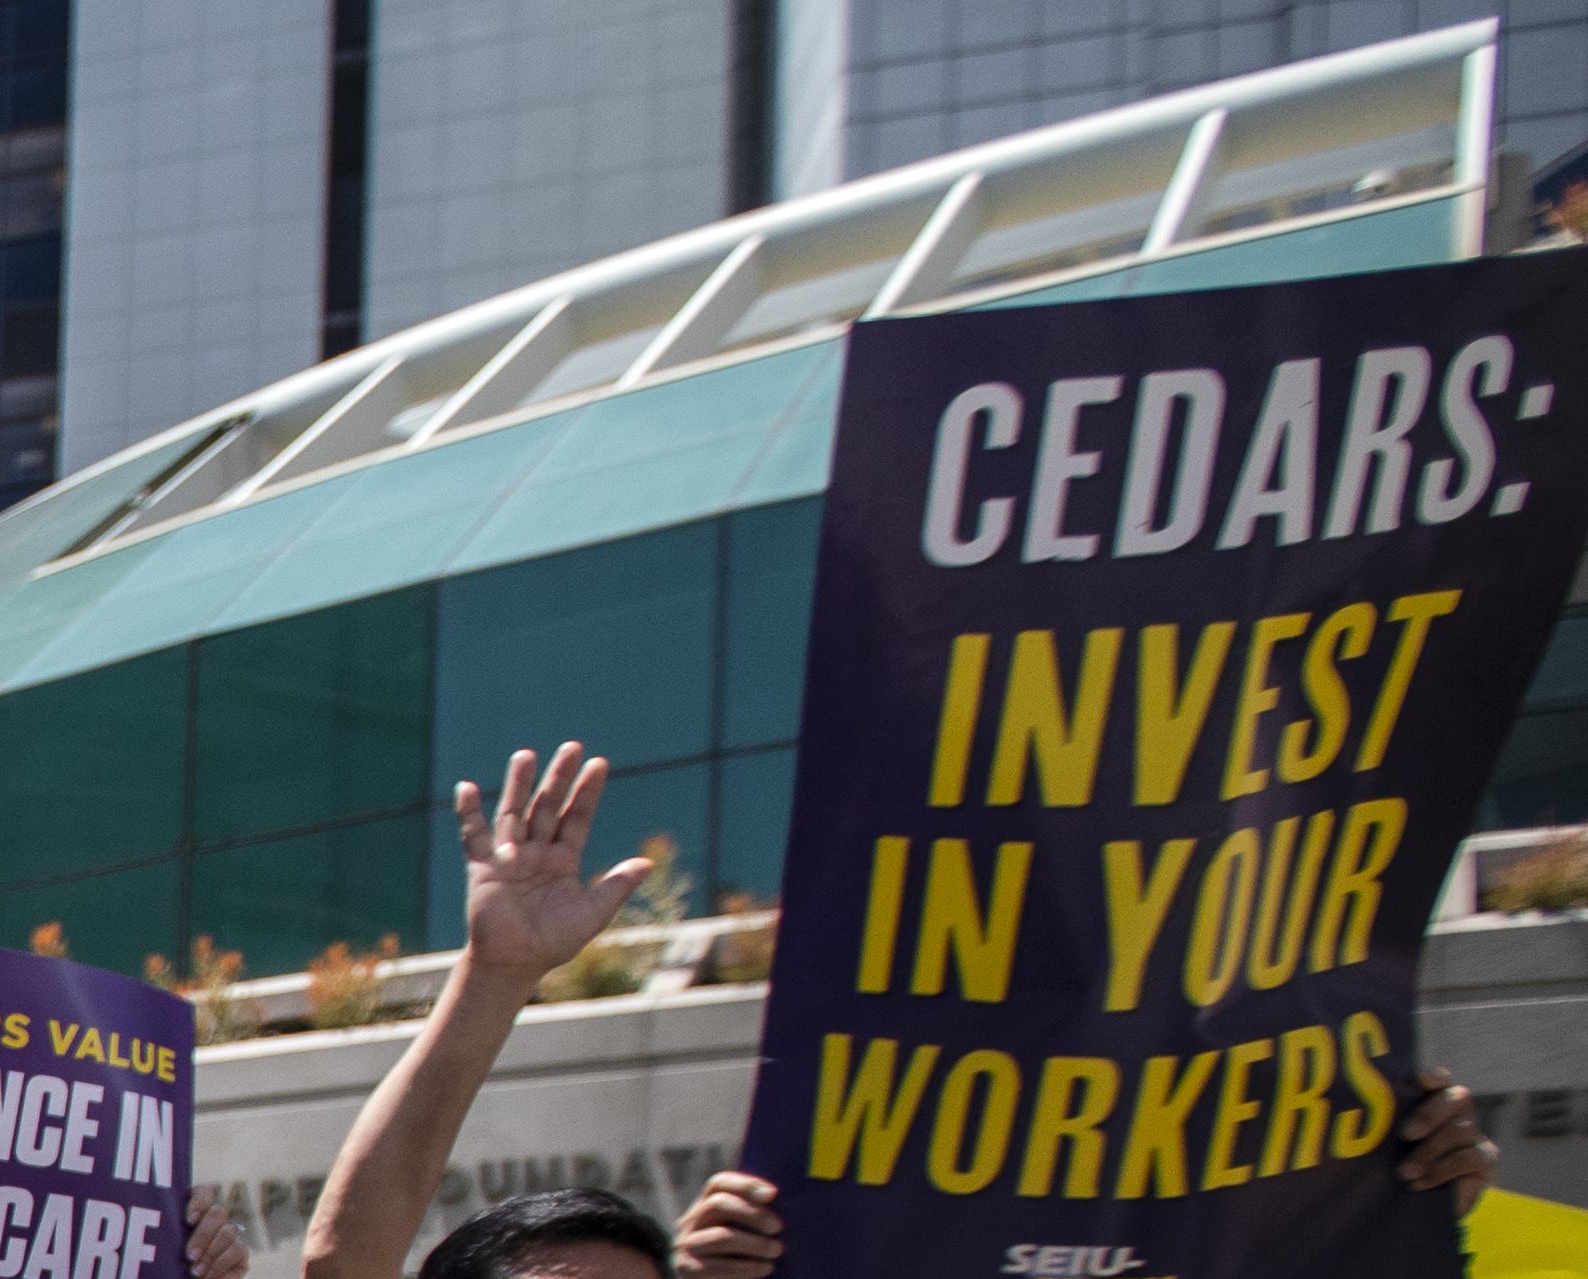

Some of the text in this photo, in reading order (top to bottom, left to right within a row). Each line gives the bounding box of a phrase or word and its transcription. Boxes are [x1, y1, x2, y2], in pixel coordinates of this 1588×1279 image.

[923, 335, 1552, 567] CEDARS:
[930, 590, 1460, 807] INVEST
[858, 797, 1406, 1012] IN YOUR
[48, 1019, 175, 1083] VALUE
[113, 1090, 173, 1189] IN
[810, 1012, 1394, 1199] WORKERS
[999, 1244, 1147, 1276] SEIU-
